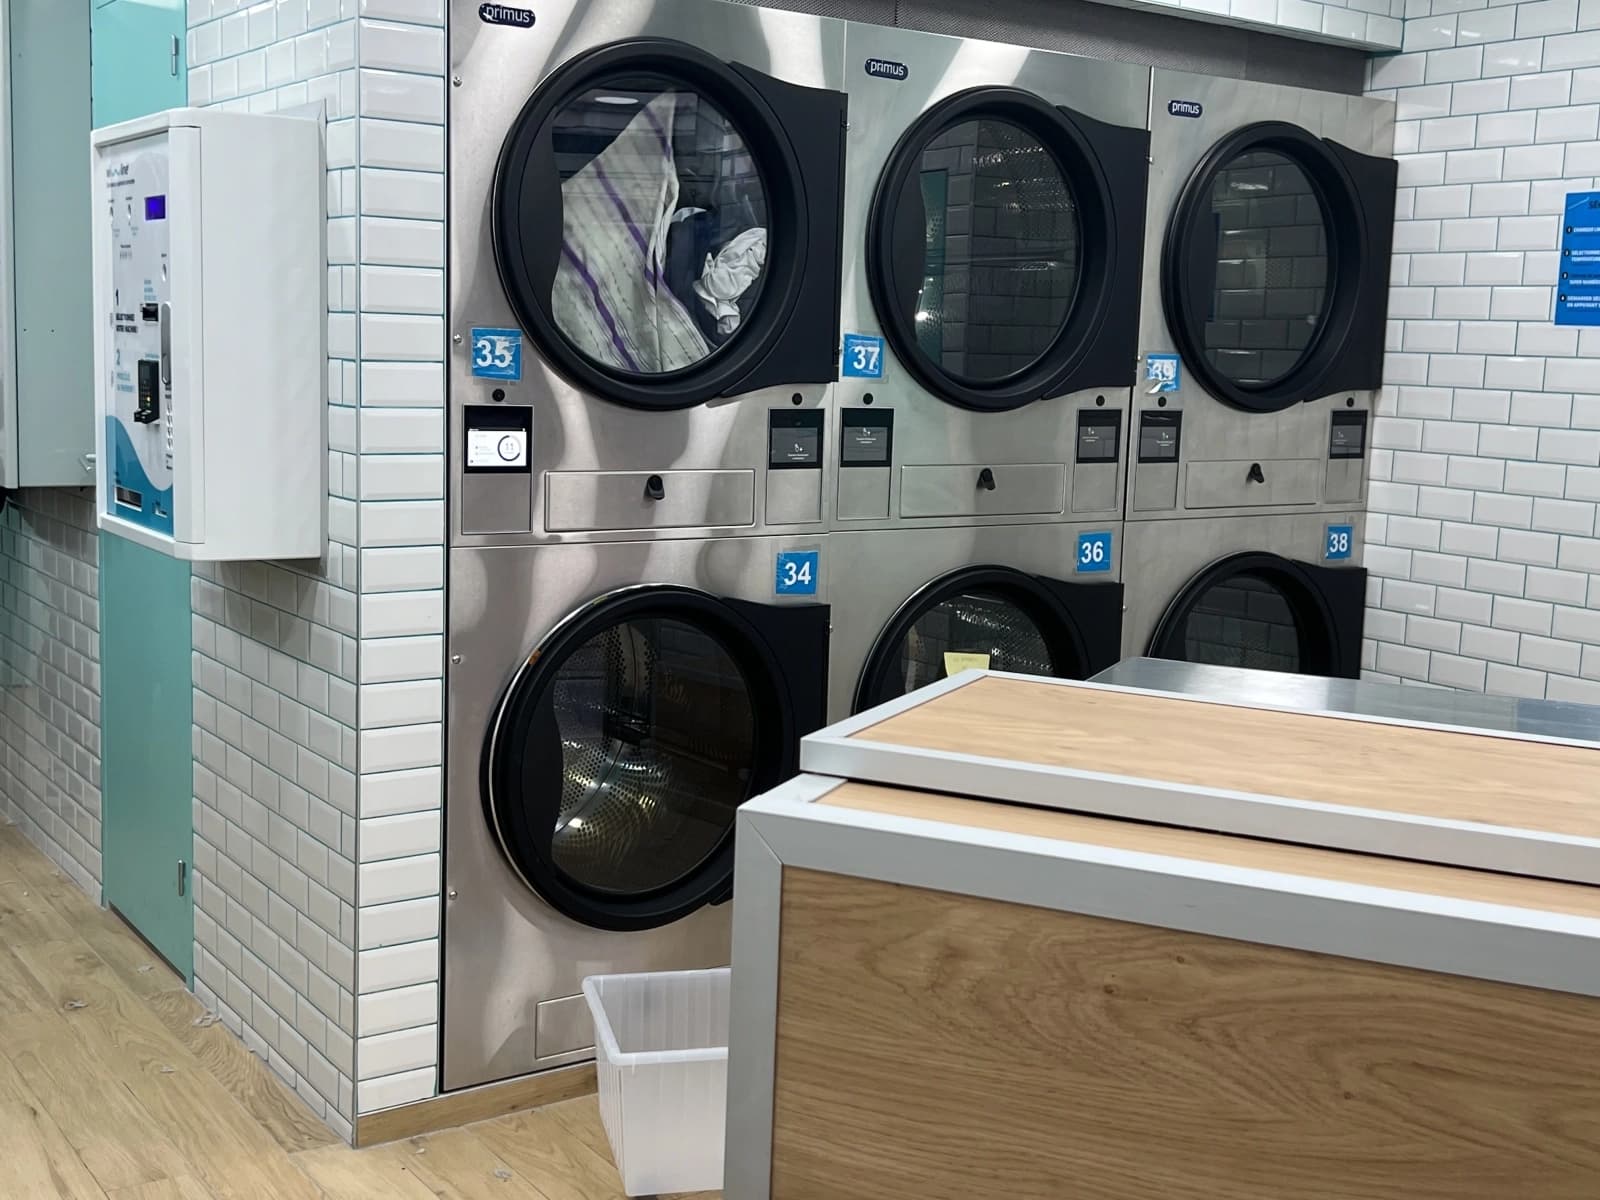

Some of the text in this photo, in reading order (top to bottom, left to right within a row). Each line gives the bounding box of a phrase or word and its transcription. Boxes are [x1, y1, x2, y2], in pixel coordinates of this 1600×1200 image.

[486, 6, 530, 23] primus
[870, 61, 904, 76] primus
[1172, 102, 1200, 114] primus
[476, 340, 513, 368] 35
[853, 345, 881, 371] 37
[1081, 541, 1104, 564] 36
[1330, 532, 1348, 553] 38
[784, 561, 812, 586] 34
